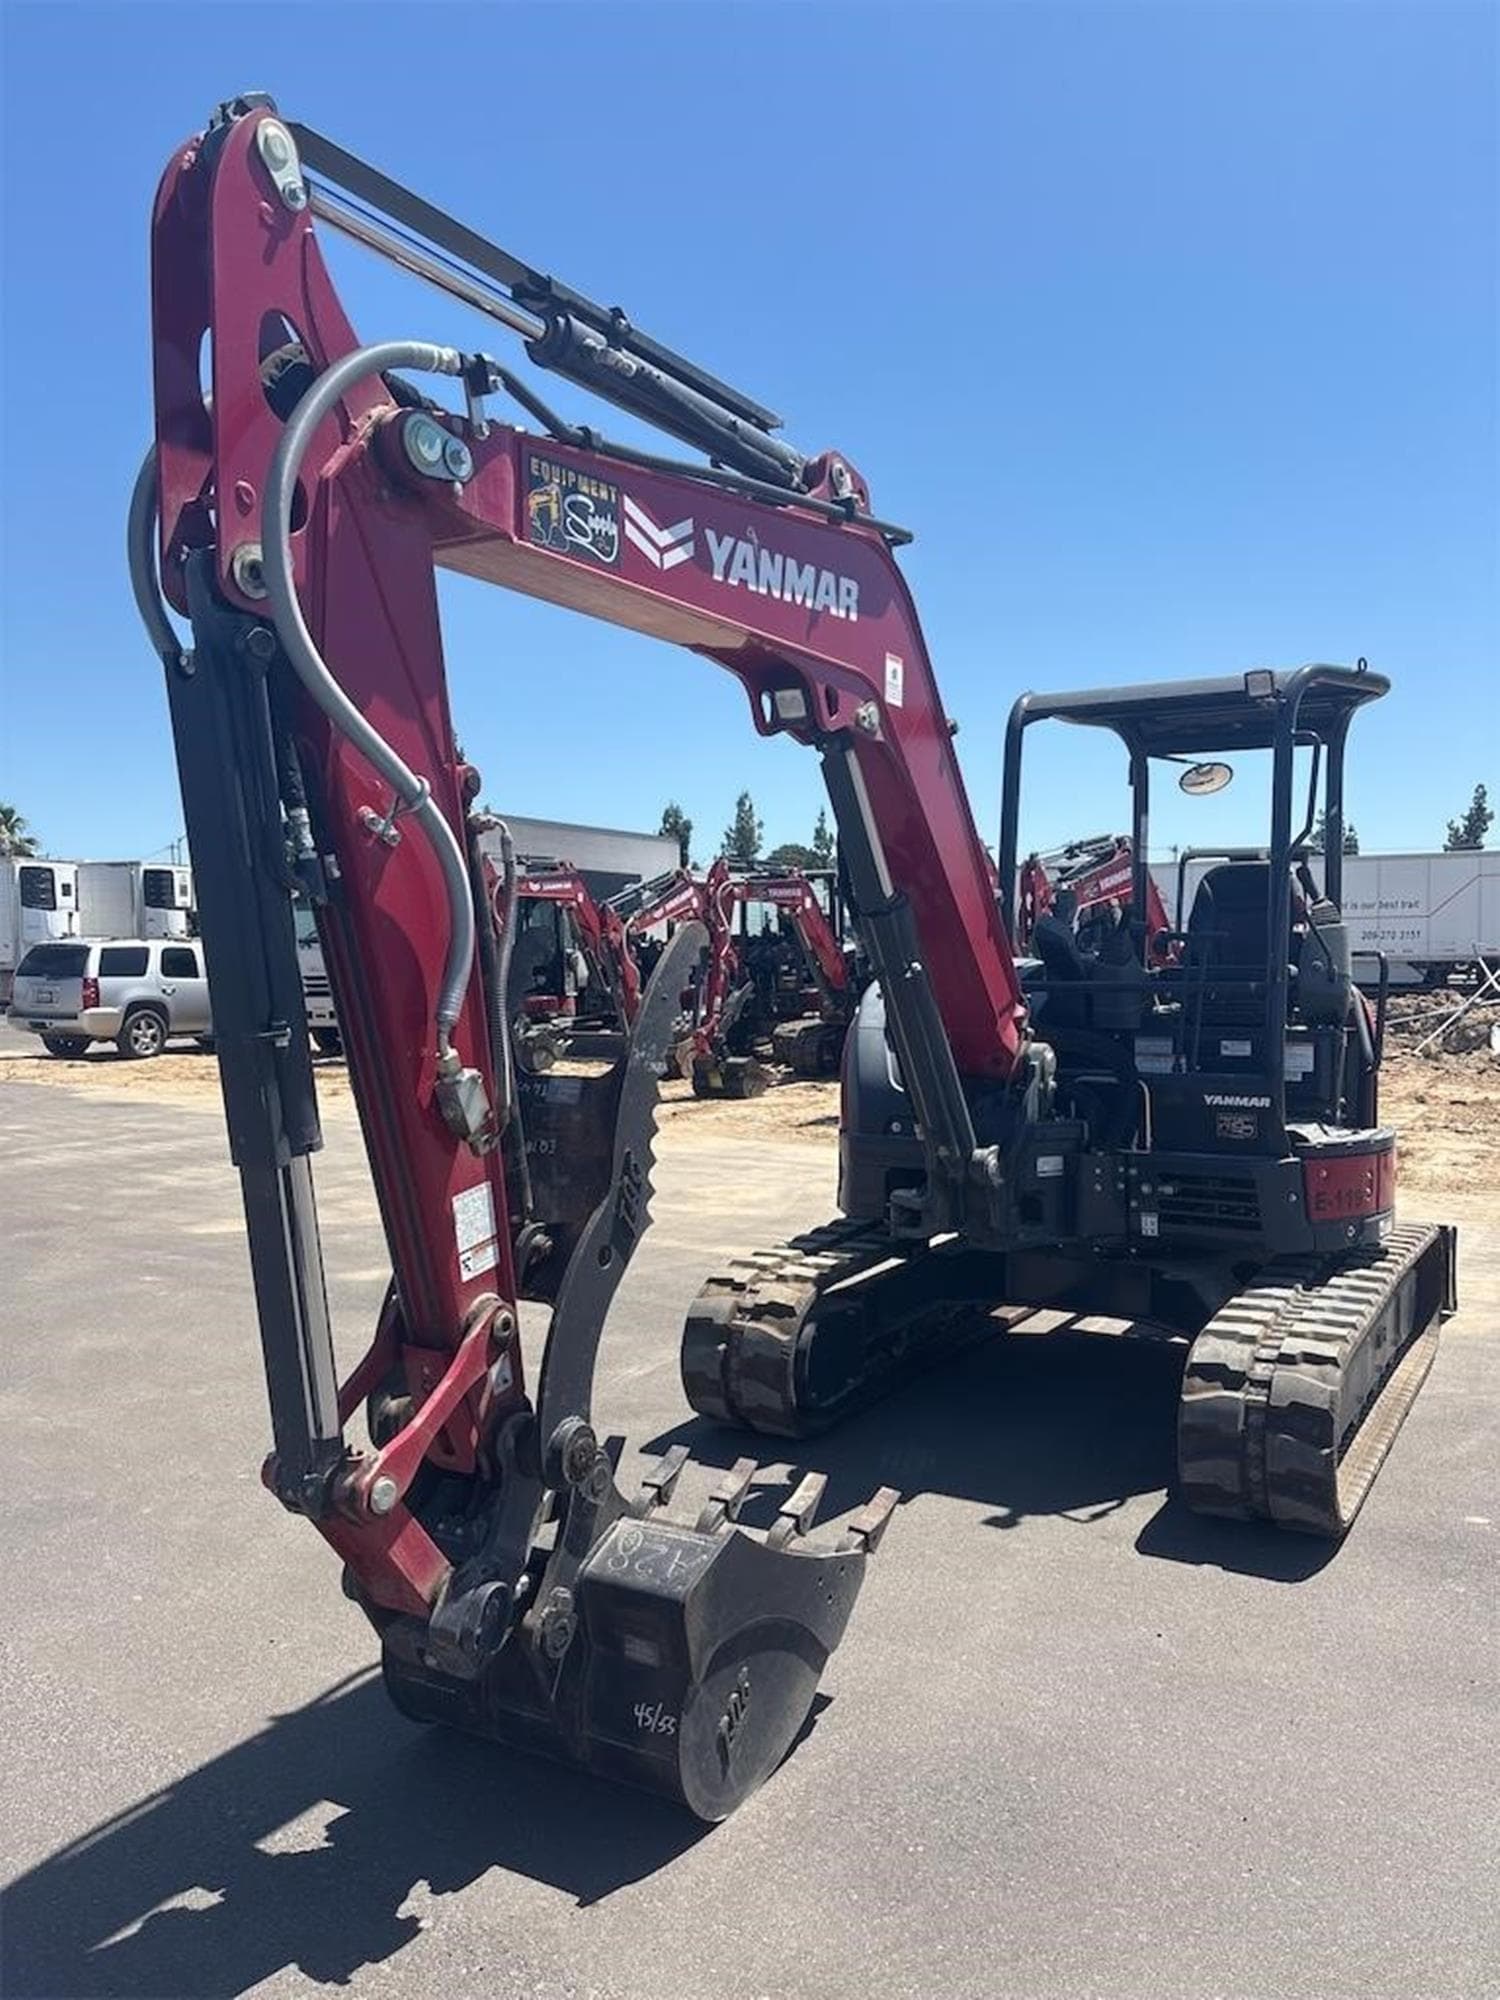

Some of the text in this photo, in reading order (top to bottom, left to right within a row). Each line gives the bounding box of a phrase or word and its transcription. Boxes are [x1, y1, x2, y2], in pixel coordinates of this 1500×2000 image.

[530, 457, 617, 503] EQUIPMENT
[704, 527, 859, 622] YANMAR
[1203, 1095, 1271, 1108] YANMAR
